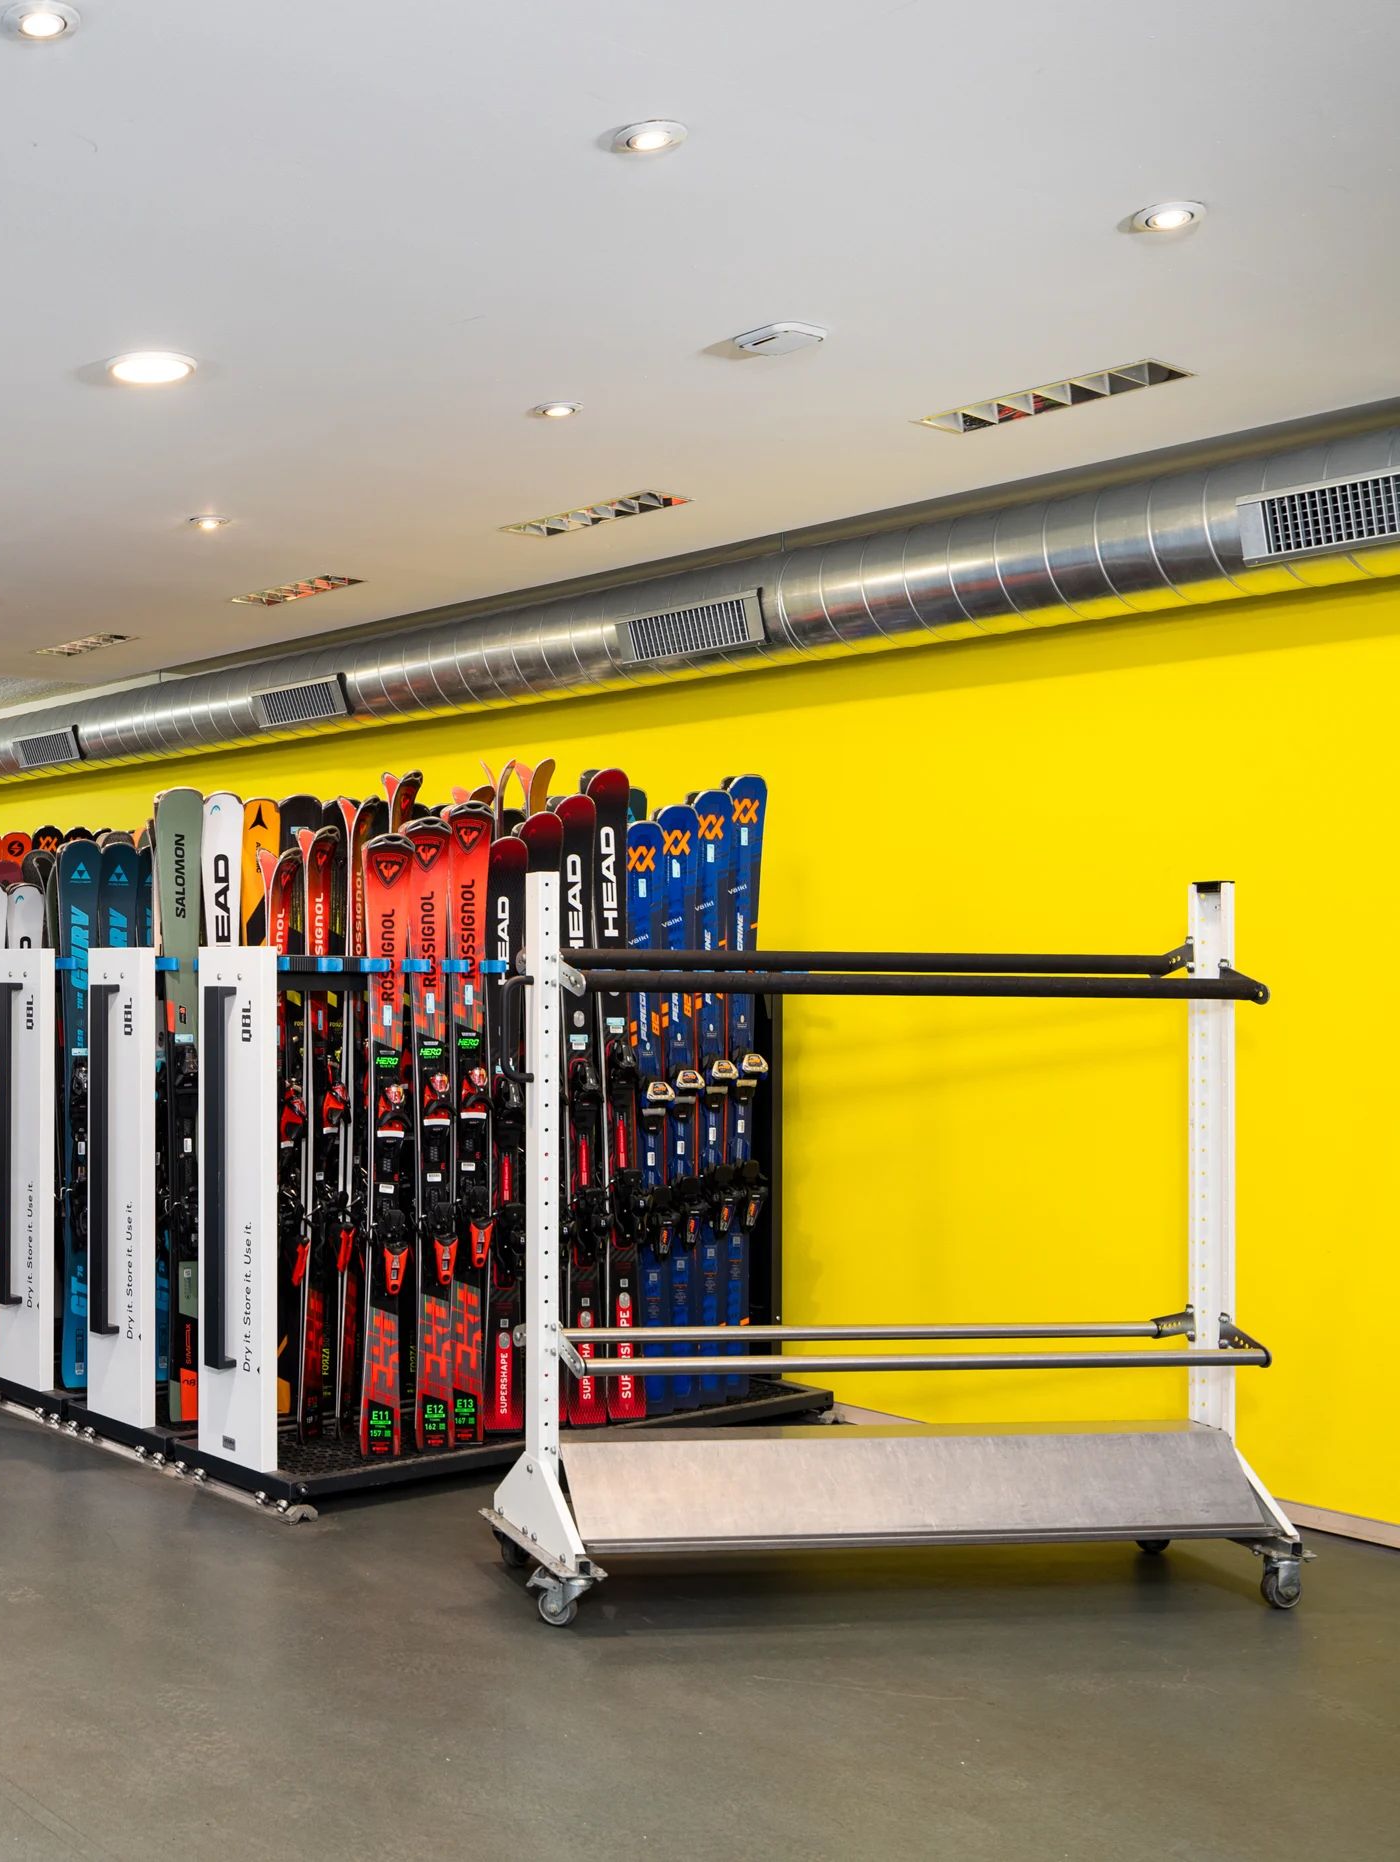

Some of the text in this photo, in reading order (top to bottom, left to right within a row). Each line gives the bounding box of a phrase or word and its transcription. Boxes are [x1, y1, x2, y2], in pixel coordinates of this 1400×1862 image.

[174, 833, 186, 919] SALOMON
[600, 826, 619, 937] HEAD
[214, 854, 231, 947] EAD
[315, 893, 324, 955] SIGNOL
[736, 912, 745, 951] GRINE
[420, 1048, 443, 1056] HERO
[457, 1039, 480, 1047] HERO
[376, 1057, 399, 1065] HERO
[26, 1286, 35, 1308] Dry
[243, 1221, 253, 1372] Dry it. Store it. Use it.
[126, 1315, 135, 1340] Dry
[500, 1352, 509, 1414] SUPERSHAPE
[372, 1411, 389, 1420] E11
[426, 1405, 444, 1414] E12
[456, 1399, 474, 1408] E13
